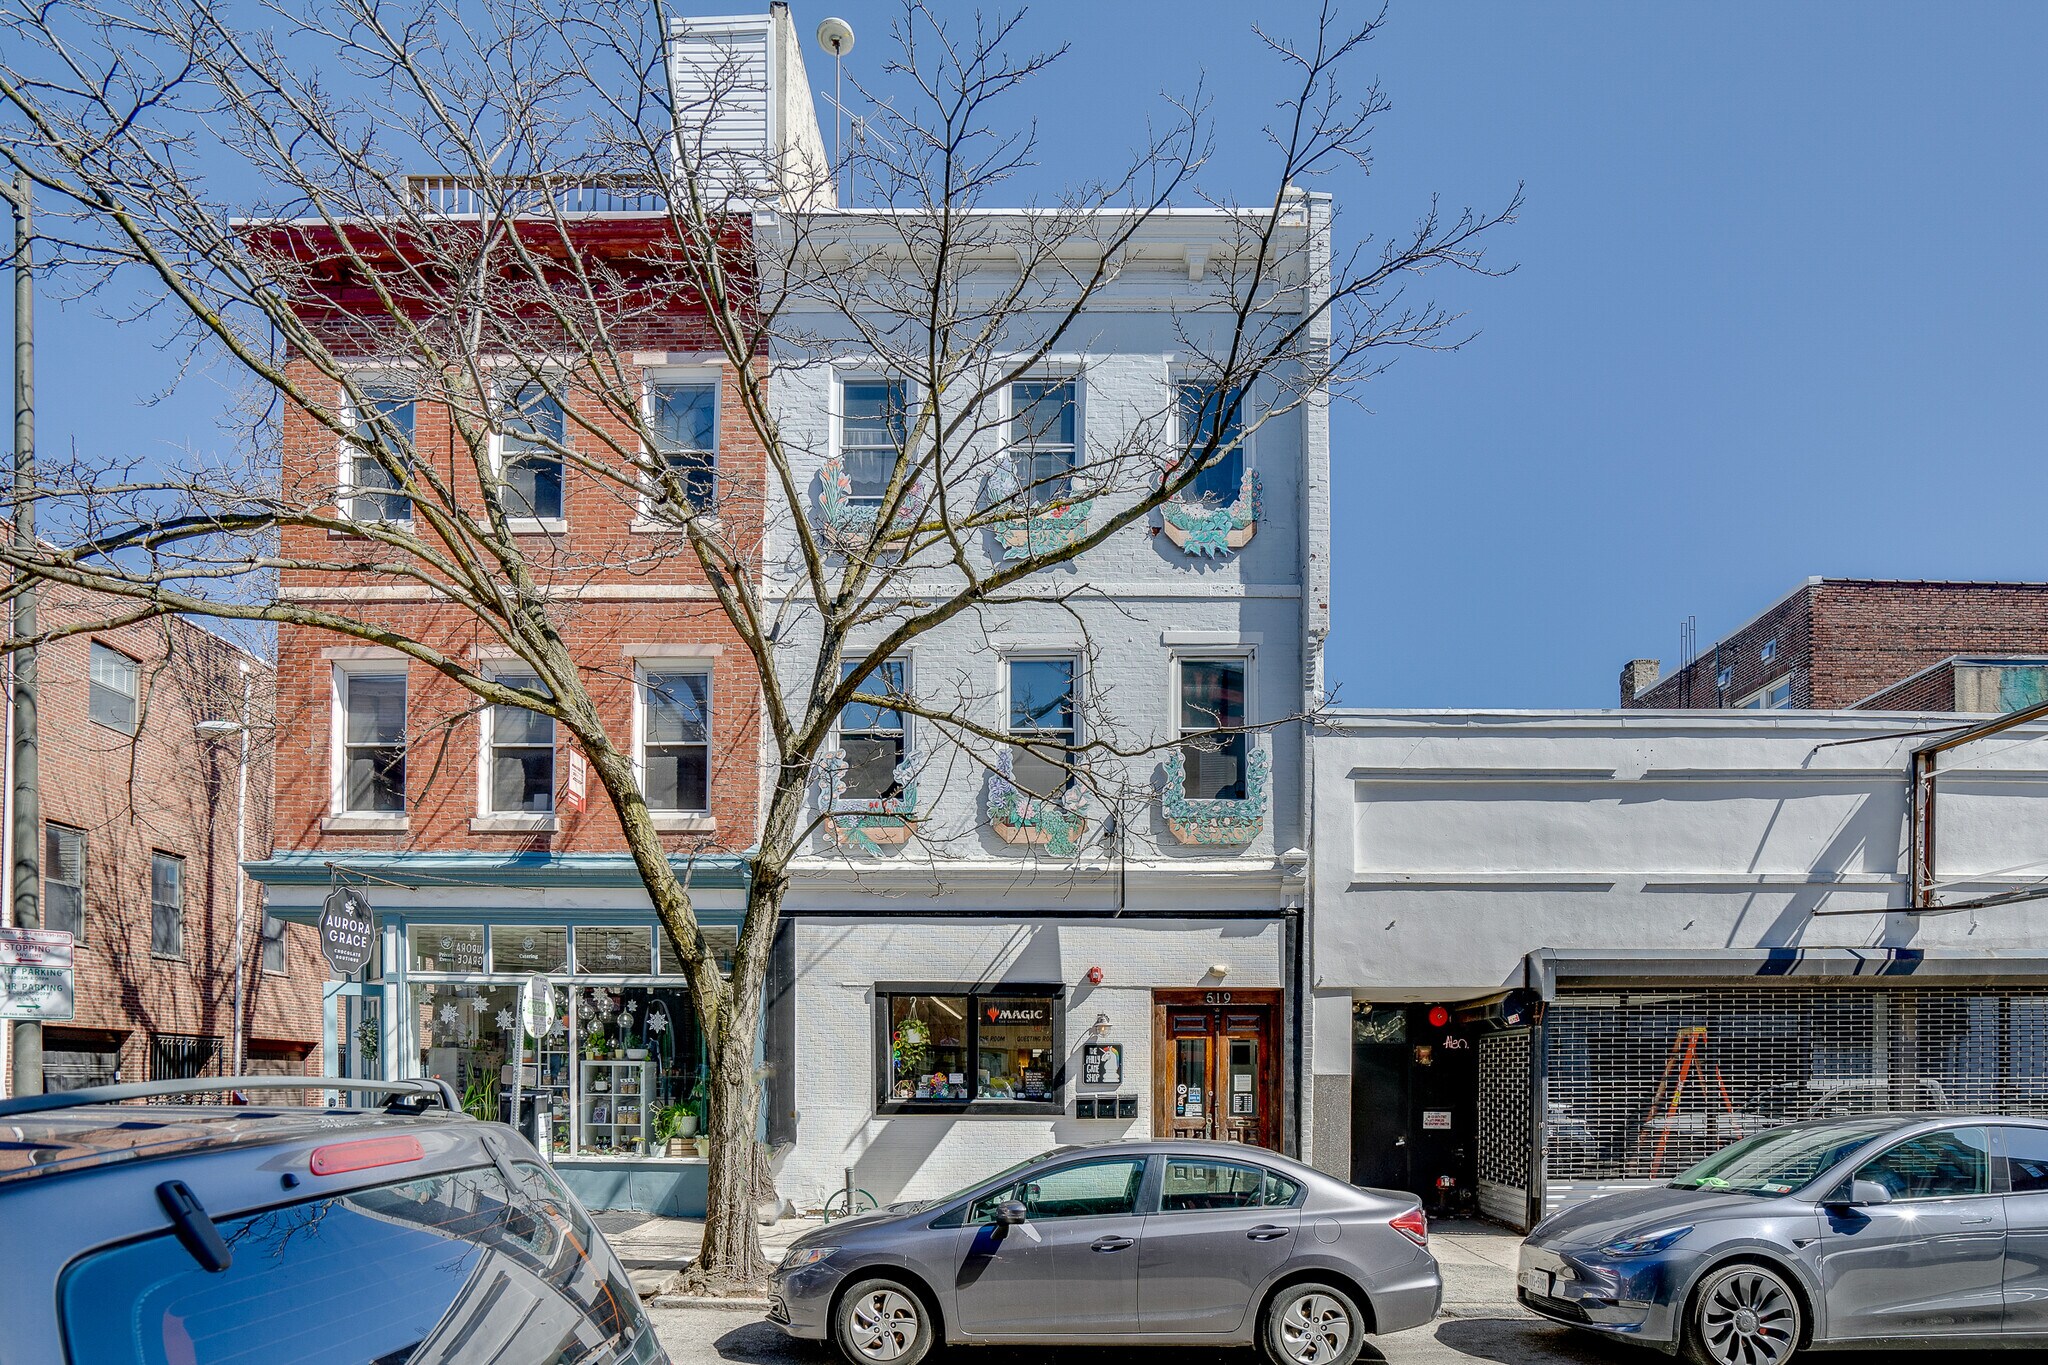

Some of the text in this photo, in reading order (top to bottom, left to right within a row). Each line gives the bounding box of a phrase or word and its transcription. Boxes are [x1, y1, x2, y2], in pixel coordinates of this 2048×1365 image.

[326, 915, 370, 935] AURORA
[329, 930, 366, 948] GRACE
[4, 944, 51, 953] STOPPING
[334, 948, 361, 957] CHOCOLATE
[335, 955, 359, 963] BOUTIQUE
[22, 968, 63, 977] PARKING
[4, 982, 63, 992] HR PARKING
[1206, 992, 1231, 1004] 519
[999, 1010, 1043, 1020] MAGIC
[1089, 1047, 1098, 1055] THE
[1086, 1055, 1101, 1065] PHILLY
[1086, 1064, 1100, 1074] GAME
[1086, 1073, 1101, 1083] SHOP
